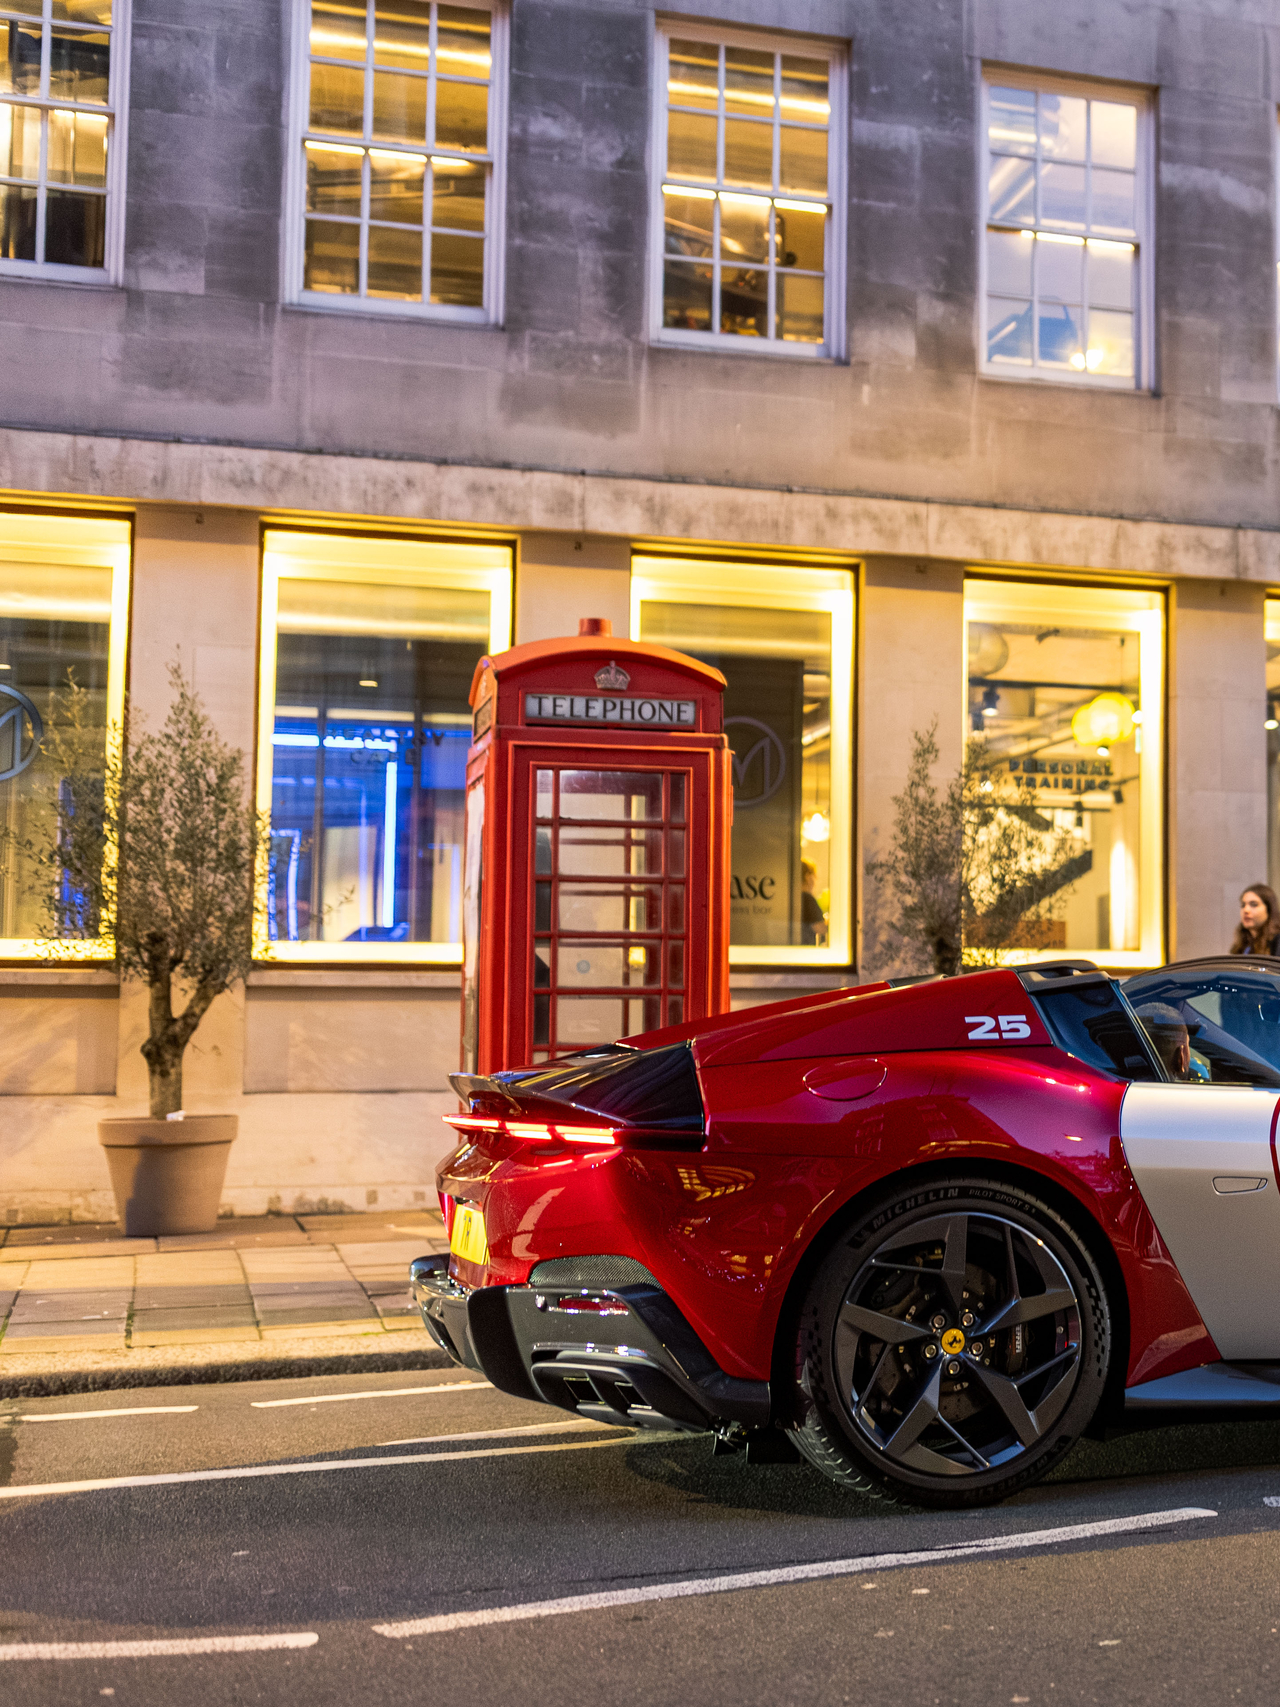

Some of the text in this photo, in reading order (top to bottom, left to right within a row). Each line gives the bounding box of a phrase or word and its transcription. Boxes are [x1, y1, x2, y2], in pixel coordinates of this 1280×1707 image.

[531, 695, 690, 723] TELEPHONE
[1009, 759, 1113, 776] PERSONAL
[1014, 776, 1110, 791] TRAINING
[964, 1014, 1031, 1040] 25
[872, 1187, 960, 1230] MICHELIN
[968, 1188, 995, 1199] PILOT
[995, 1192, 1023, 1208] SPORT
